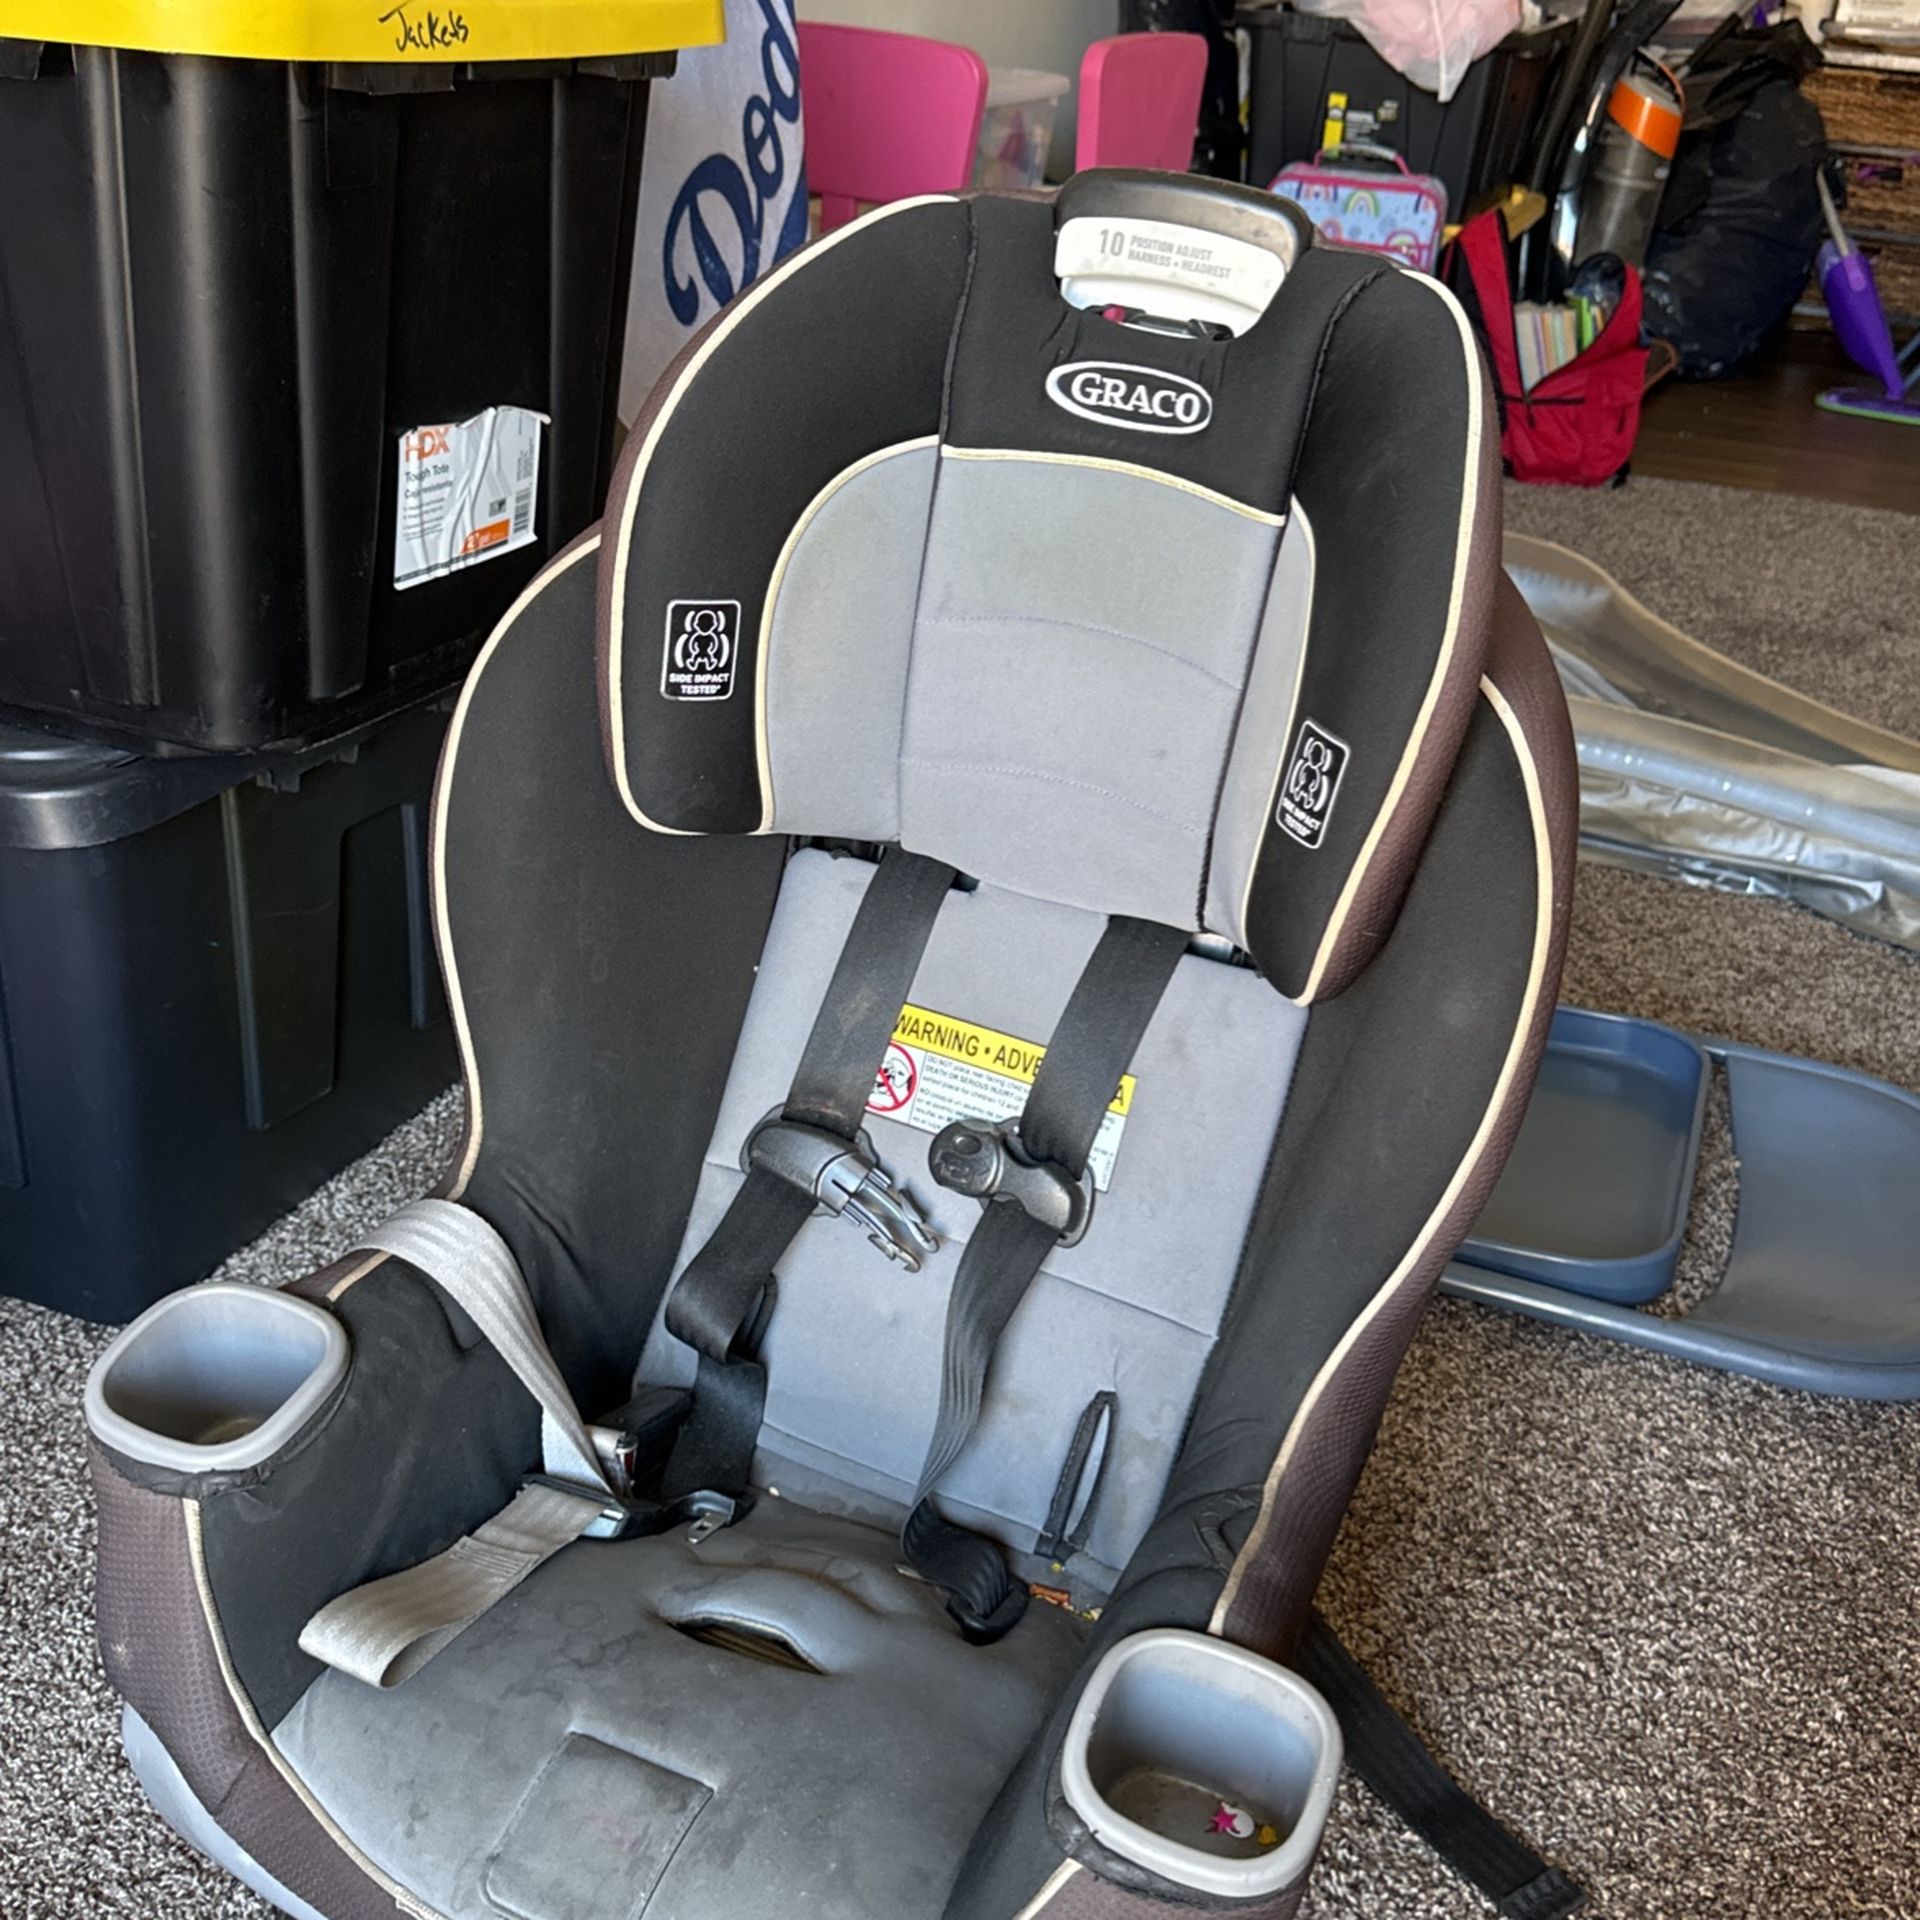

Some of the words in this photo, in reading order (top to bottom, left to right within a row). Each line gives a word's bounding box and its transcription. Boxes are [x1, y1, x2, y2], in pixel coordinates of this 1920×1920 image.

[1099, 229, 1125, 257] 10
[1130, 235, 1175, 254] POSITION
[1175, 239, 1213, 261] ADJUST
[1128, 249, 1171, 268] HARNESS
[1181, 259, 1231, 279] HEADREST
[1071, 372, 1200, 423] GRACO
[405, 427, 450, 463] HDX
[669, 673, 692, 683] SIDE
[694, 673, 730, 683] IMPACT
